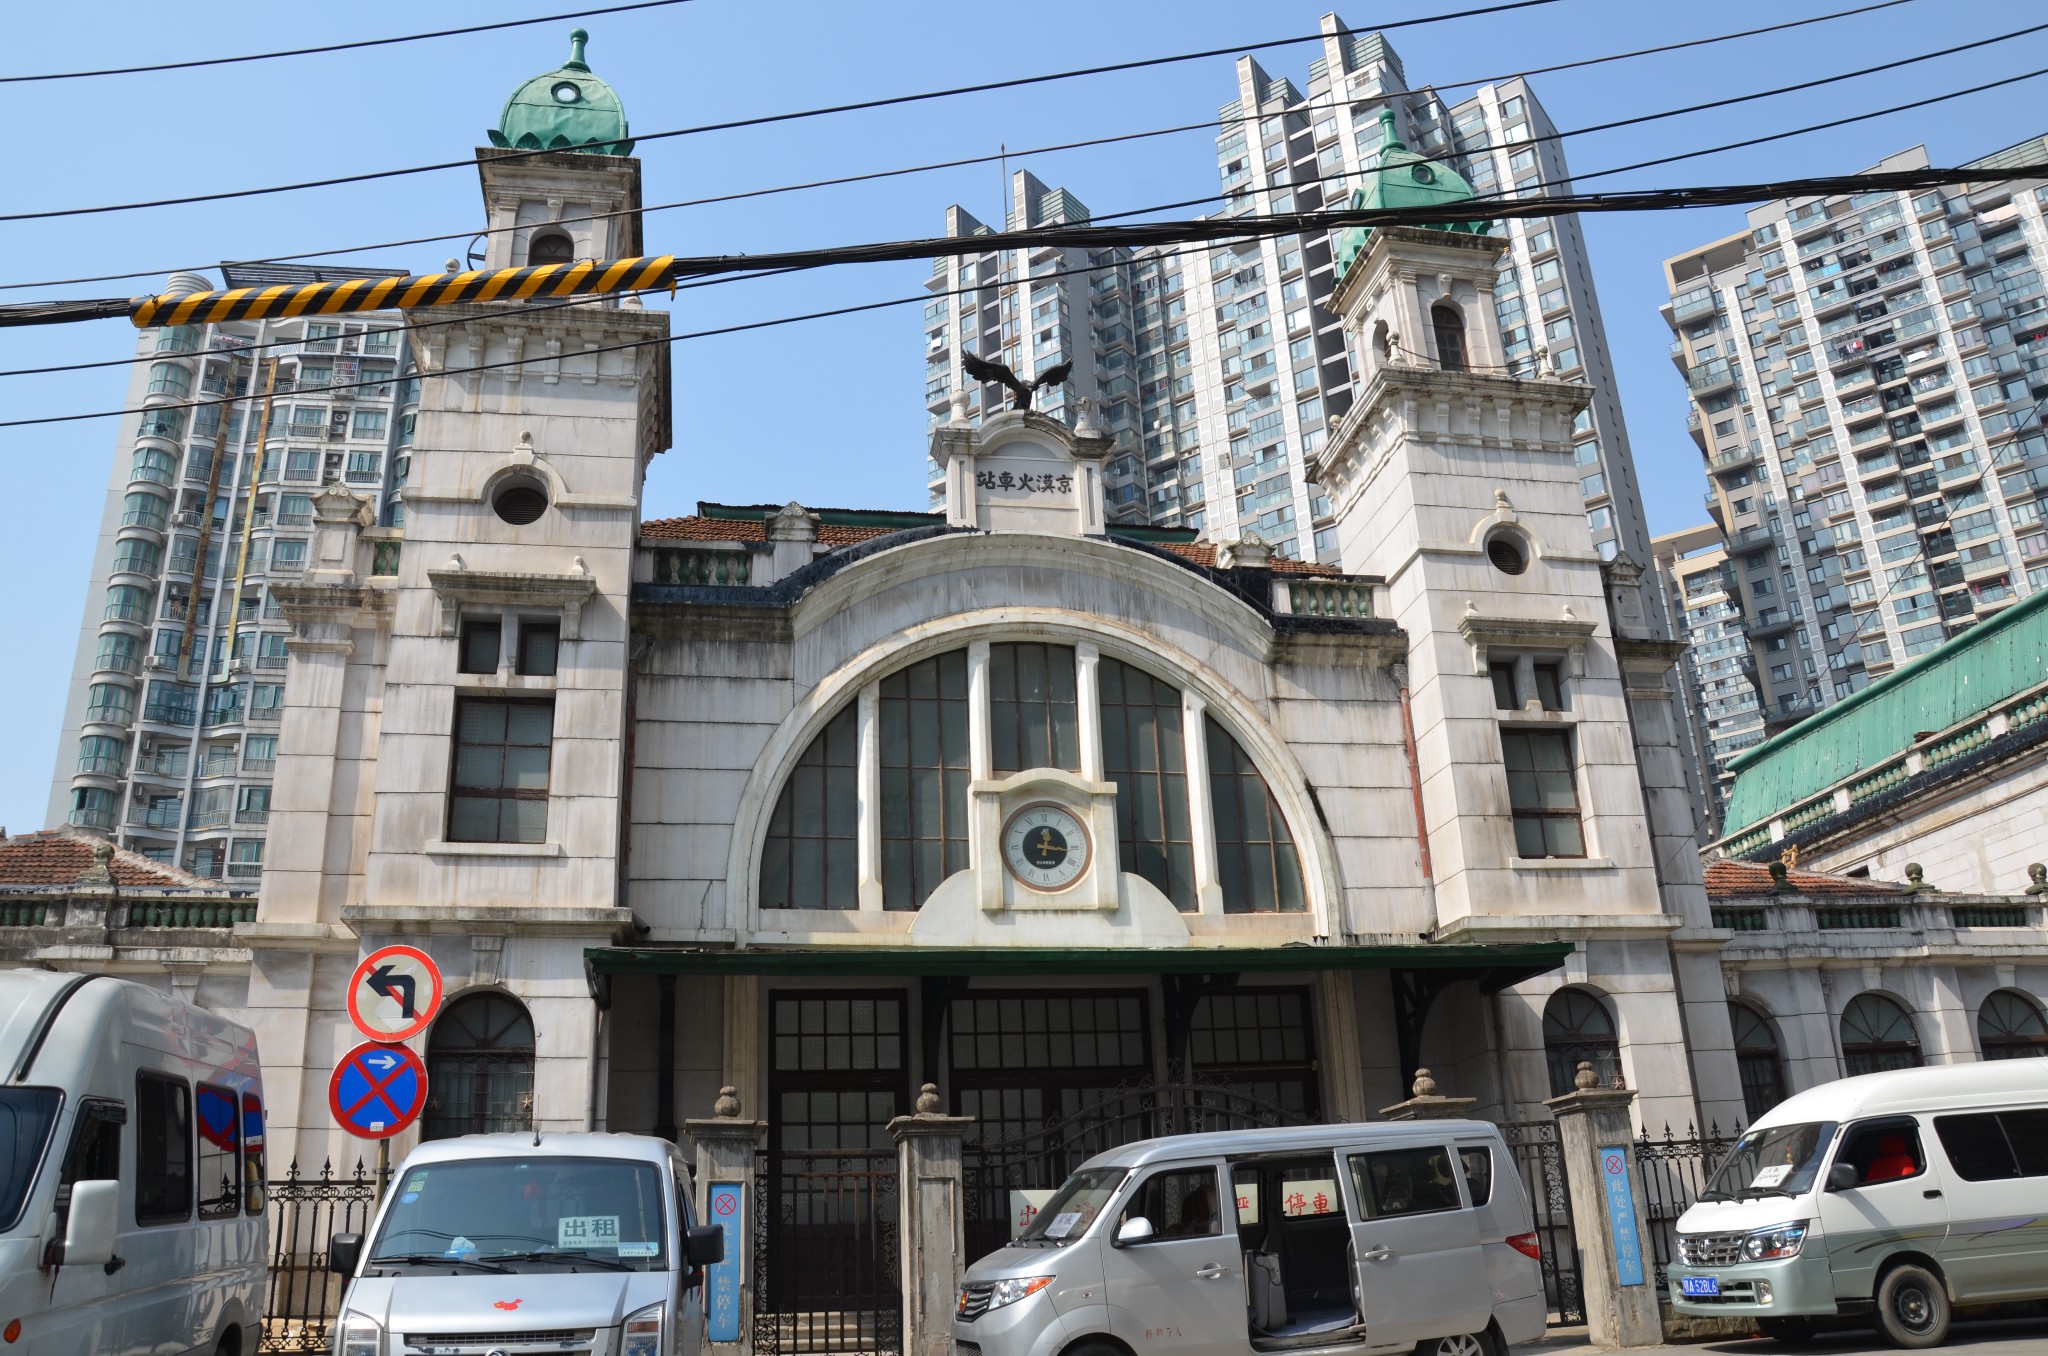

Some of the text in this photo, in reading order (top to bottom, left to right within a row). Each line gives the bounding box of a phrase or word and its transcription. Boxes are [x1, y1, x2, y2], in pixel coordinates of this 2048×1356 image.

[976, 470, 1074, 494] 京漢火車站
[1285, 1192, 1329, 1216] 停車
[563, 1218, 618, 1238] 出租
[1611, 1179, 1635, 1274] 此处严禁停车
